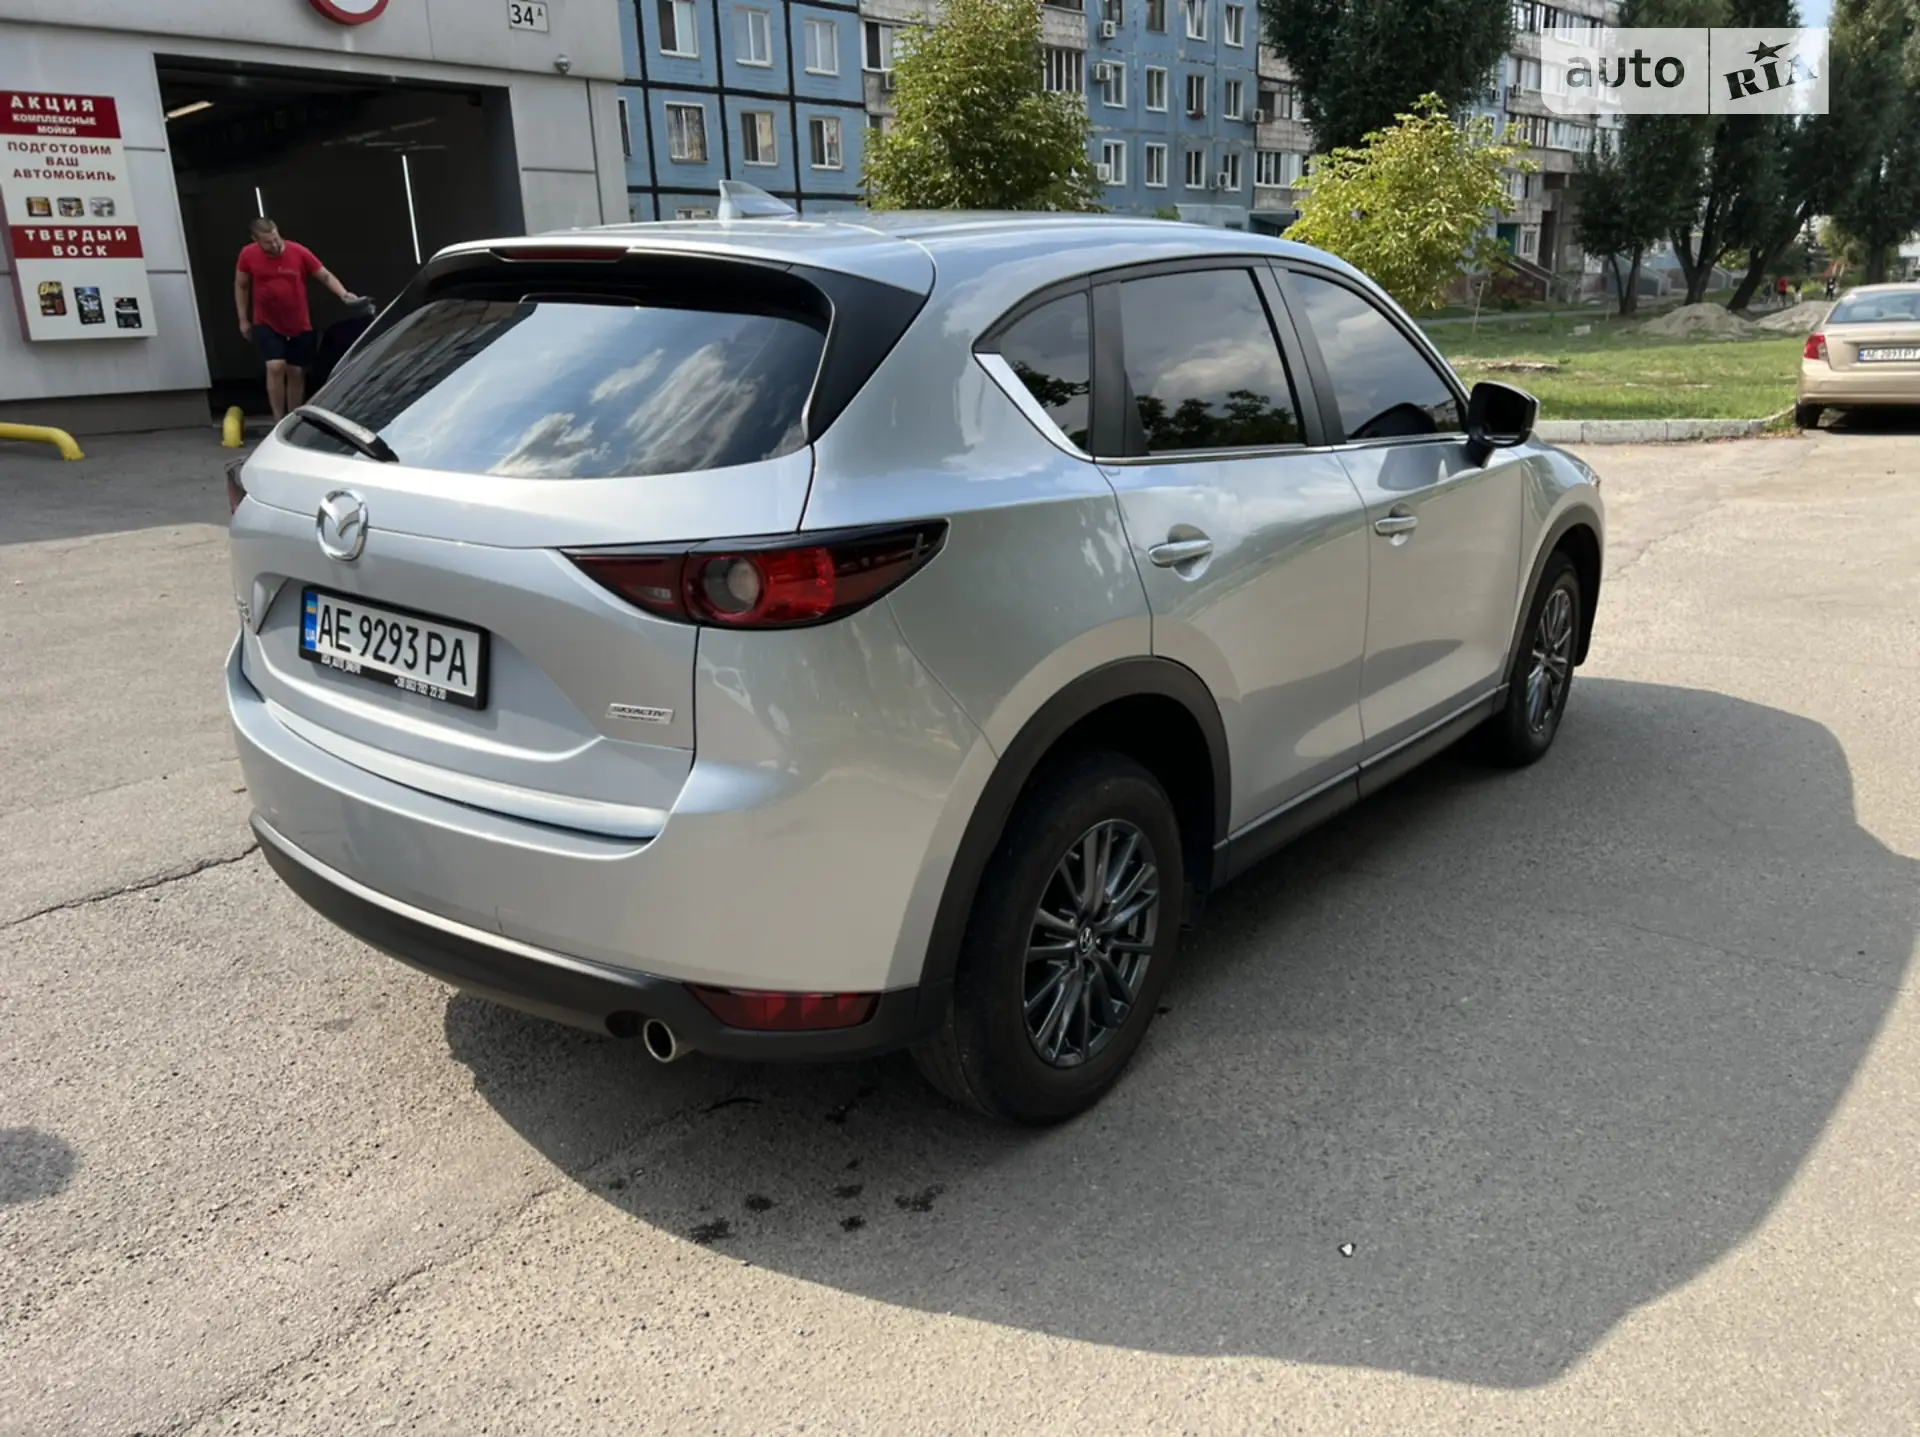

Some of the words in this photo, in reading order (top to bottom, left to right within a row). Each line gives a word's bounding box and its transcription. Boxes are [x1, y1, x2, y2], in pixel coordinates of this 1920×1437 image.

[11, 95, 94, 112] АКЦИЯ
[12, 113, 96, 125] КОМПЛЕКСНЫЕ
[37, 125, 77, 135] МОЙКИ
[7, 141, 112, 155] ПОДГОТОВИМ
[45, 156, 79, 167] ВАШ
[13, 168, 116, 181] АВТОМОБИЛЬ
[24, 228, 128, 243] ТВЕРДЫЙ
[52, 245, 108, 257] ВОСК
[318, 604, 352, 653] AE
[359, 615, 420, 670] 9293
[426, 631, 468, 686] PA
